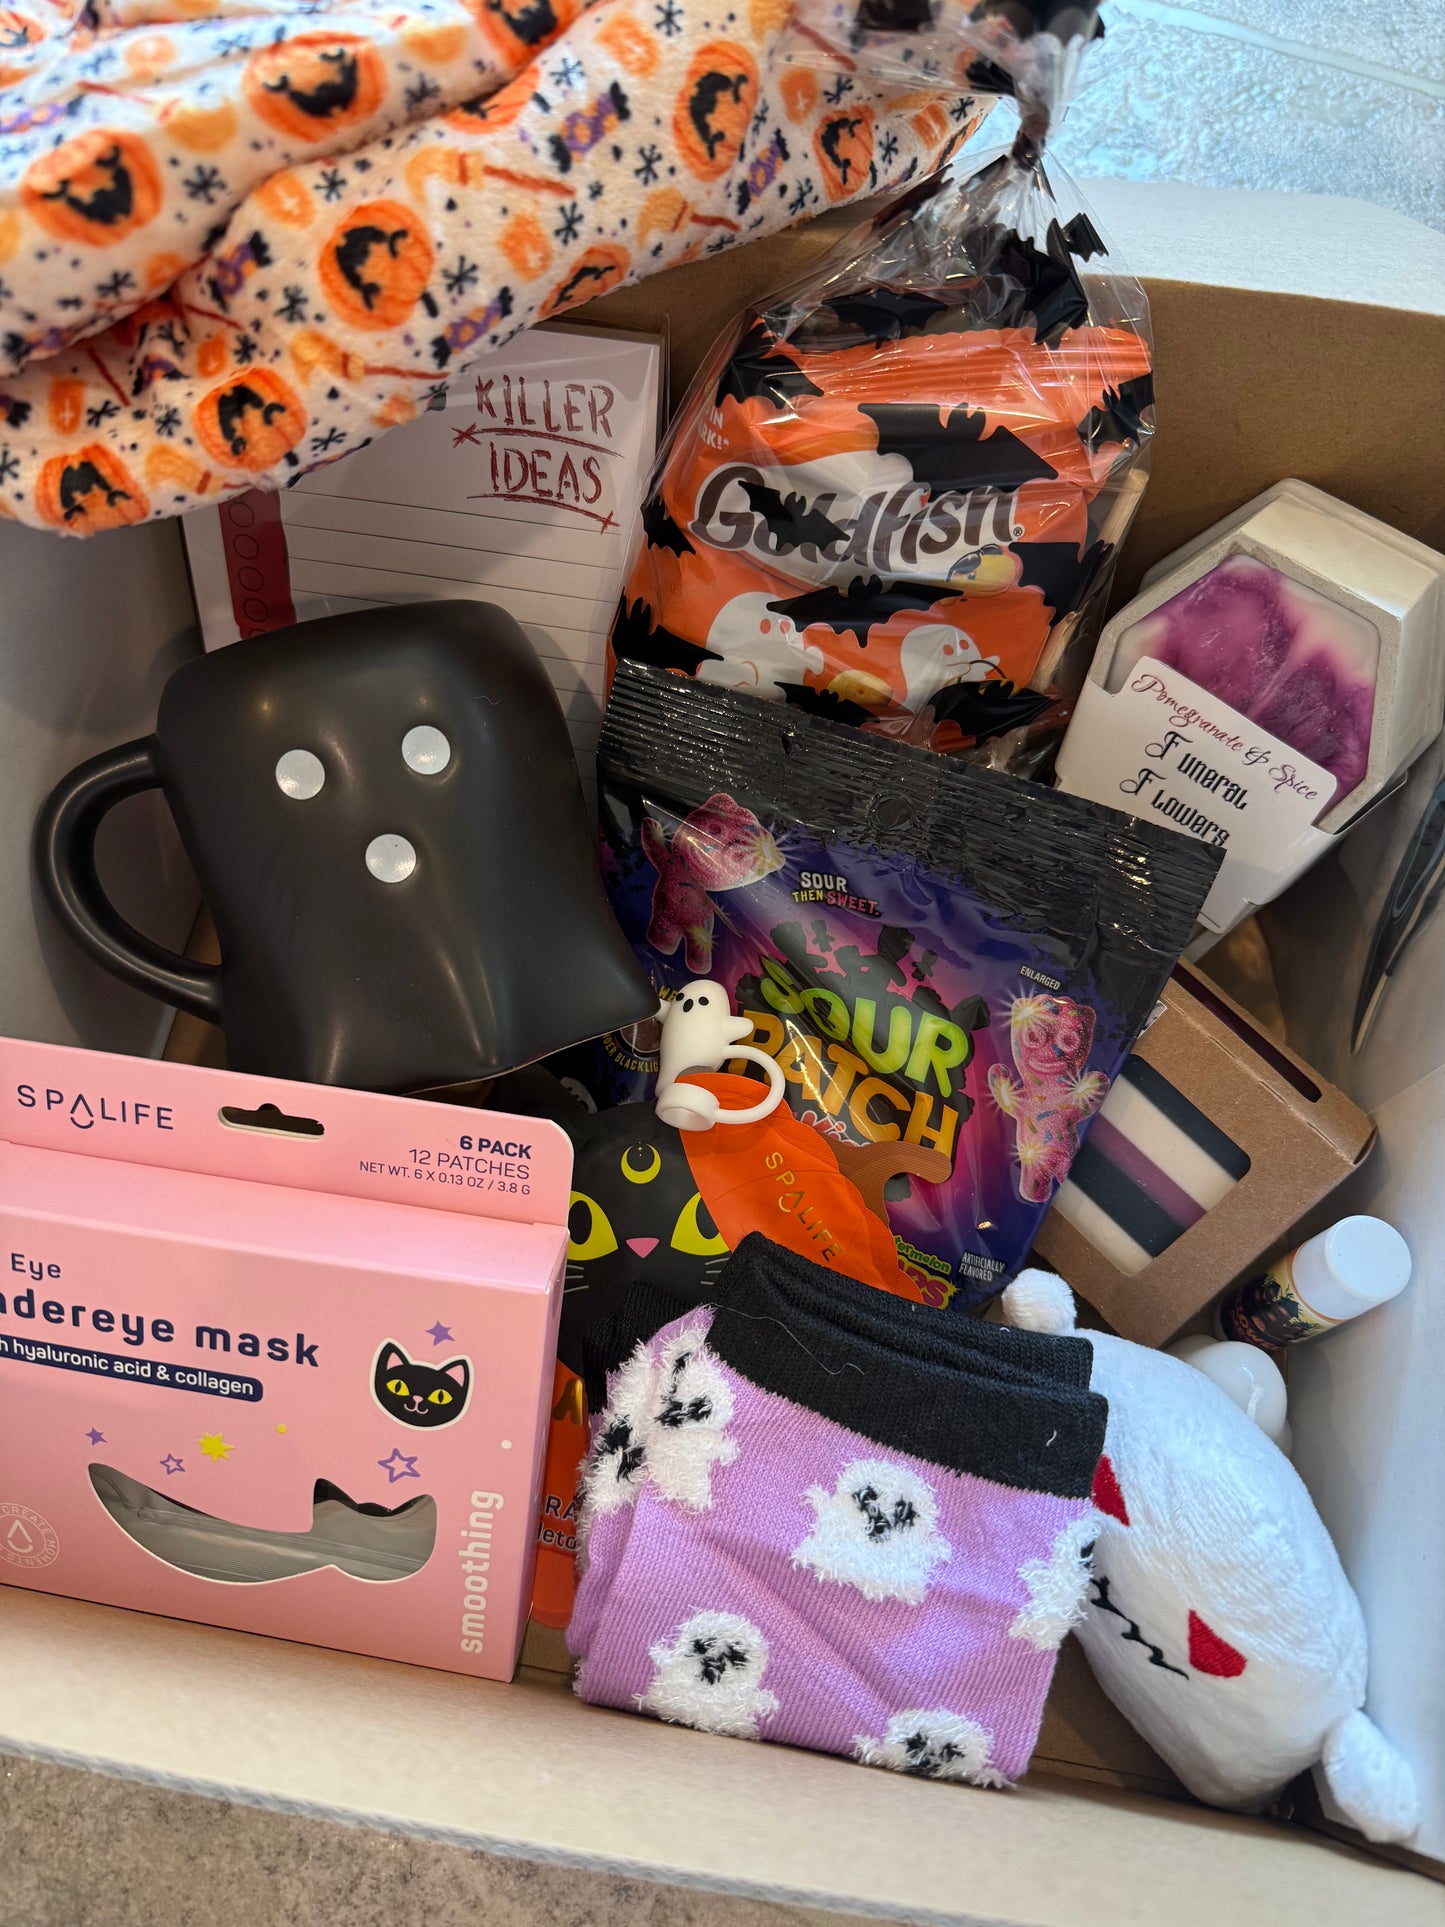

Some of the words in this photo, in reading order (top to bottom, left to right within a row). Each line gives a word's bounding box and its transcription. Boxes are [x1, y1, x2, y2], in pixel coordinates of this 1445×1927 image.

[475, 375, 613, 438] KILLER
[490, 442, 601, 503] IDEAS
[1131, 674, 1243, 751] Pomegranate
[1242, 746, 1269, 766] &
[1268, 764, 1319, 801] Spice
[801, 871, 848, 893] SOUR
[792, 889, 824, 903] THEN
[826, 891, 880, 916] SWEET.
[1020, 965, 1061, 991] ENLARGED
[760, 955, 969, 1098] SOUR
[728, 1009, 959, 1159] PATCH
[17, 1084, 174, 1130] SPALIFE
[409, 1149, 431, 1166] 12
[437, 1152, 530, 1180] PATCHES
[459, 1135, 473, 1151] 6
[478, 1137, 532, 1160] PACK
[359, 1160, 385, 1174] NET
[388, 1164, 411, 1178] WT.
[414, 1168, 423, 1180] 6
[426, 1170, 435, 1181] X
[438, 1172, 464, 1186] 0.13
[467, 1177, 484, 1189] OZ
[487, 1179, 495, 1190] /
[497, 1181, 518, 1194] 3.8
[521, 1184, 531, 1196] G
[765, 1151, 842, 1262] SPALIFE
[11, 1252, 61, 1281] Eye
[959, 1263, 993, 1282] FLAVORED
[962, 1251, 1006, 1273] ARTIFICIALLY
[195, 1326, 319, 1368] mask
[13, 1338, 109, 1370] hyaluronic
[113, 1358, 151, 1378] acid
[156, 1364, 170, 1381] &
[175, 1370, 254, 1396] collagen
[1, 1505, 53, 1536] CREATE
[458, 1490, 505, 1655] smoothing
